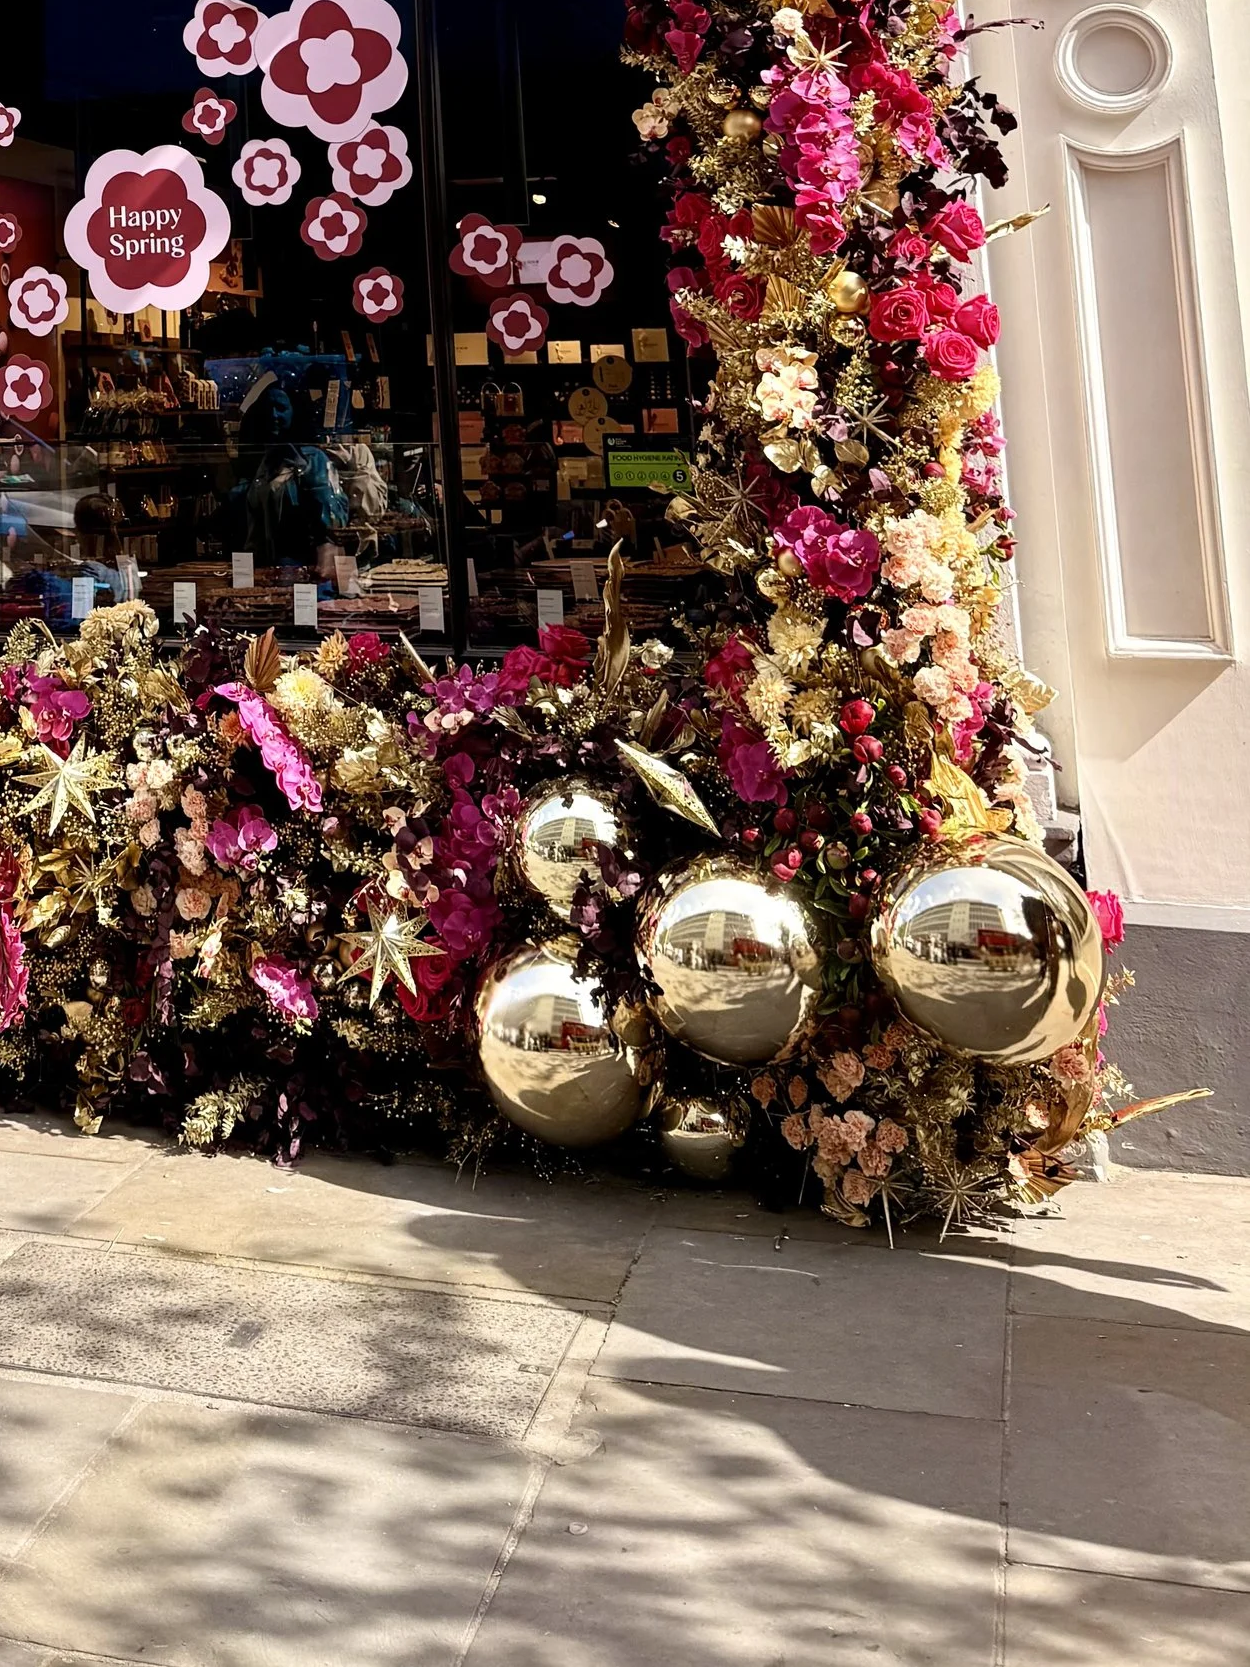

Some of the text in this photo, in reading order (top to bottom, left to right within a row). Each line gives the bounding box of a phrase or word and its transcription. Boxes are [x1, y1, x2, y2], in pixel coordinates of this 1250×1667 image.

[109, 205, 182, 231] Happy
[109, 232, 185, 260] Spring
[676, 471, 684, 482] 5
